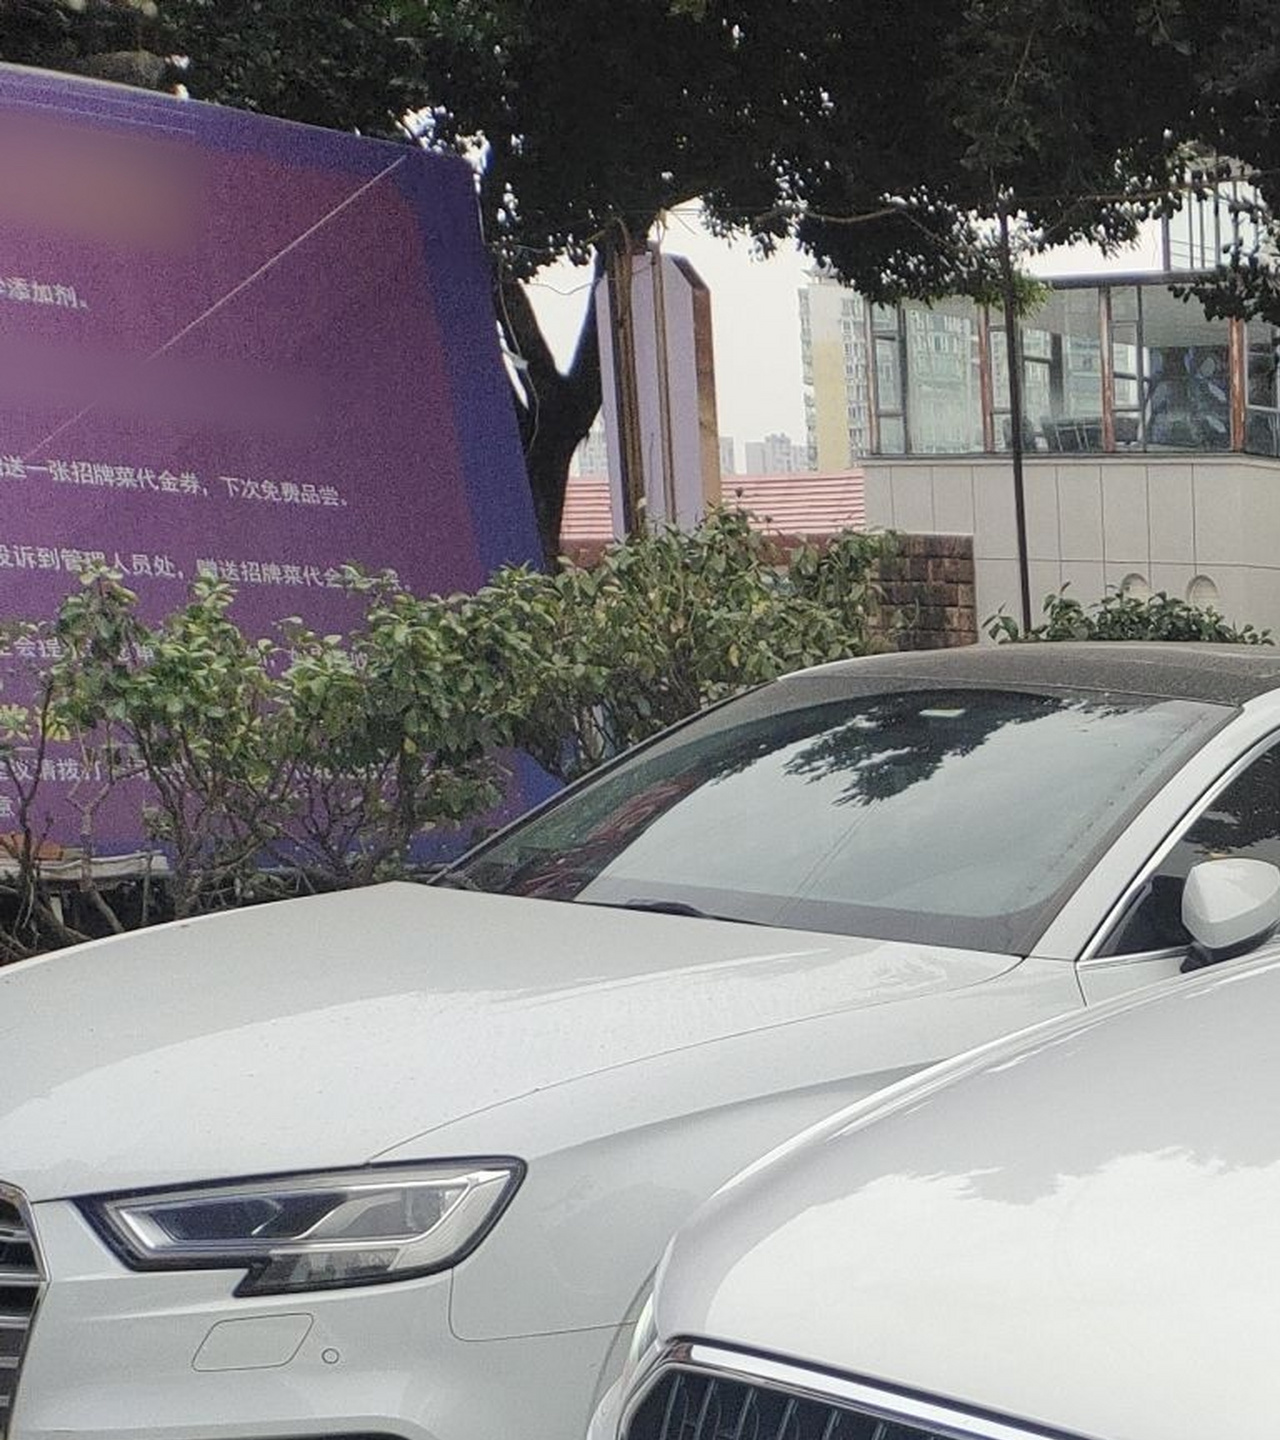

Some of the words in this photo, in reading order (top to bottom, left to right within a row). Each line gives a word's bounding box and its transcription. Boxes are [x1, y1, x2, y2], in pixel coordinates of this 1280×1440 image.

[0, 455, 347, 507] 送一张招牌菜代金券，下次免费品尝。
